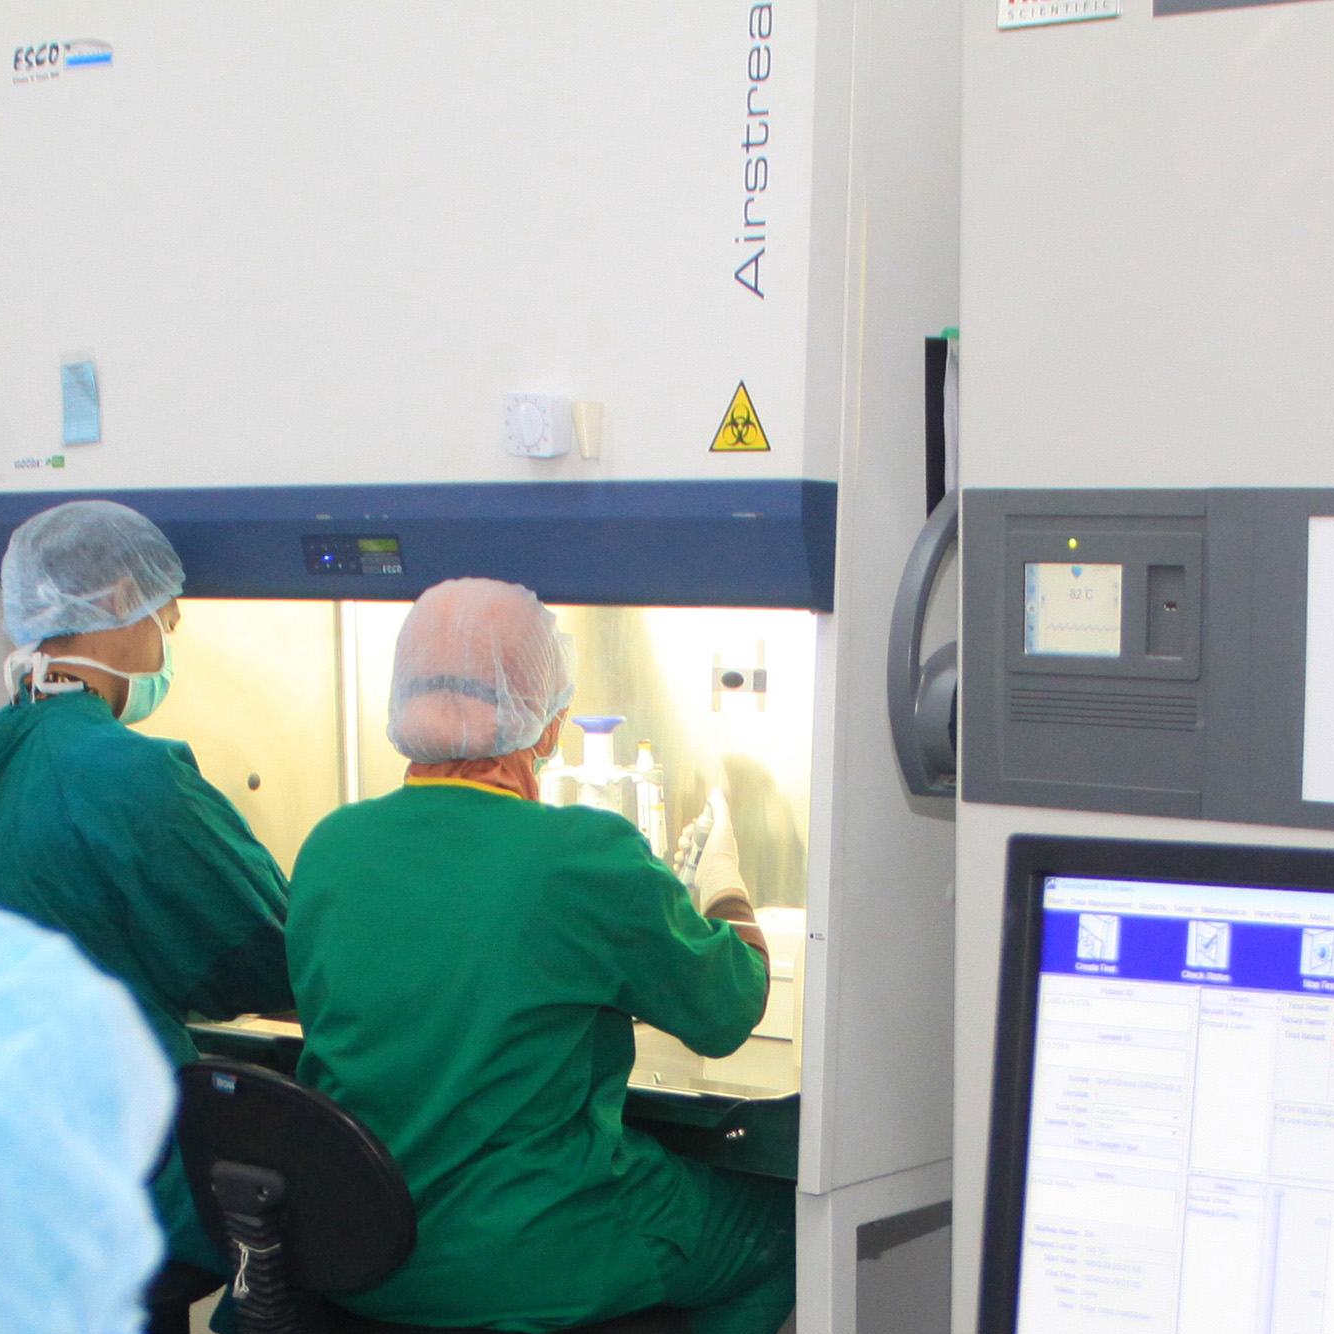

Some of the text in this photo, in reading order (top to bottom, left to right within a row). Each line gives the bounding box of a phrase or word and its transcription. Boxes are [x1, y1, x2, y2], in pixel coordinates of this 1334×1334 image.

[1008, 0, 1109, 20] SCIENTIFIC
[13, 42, 60, 71] ESCO
[1100, 963, 1118, 973] Test
